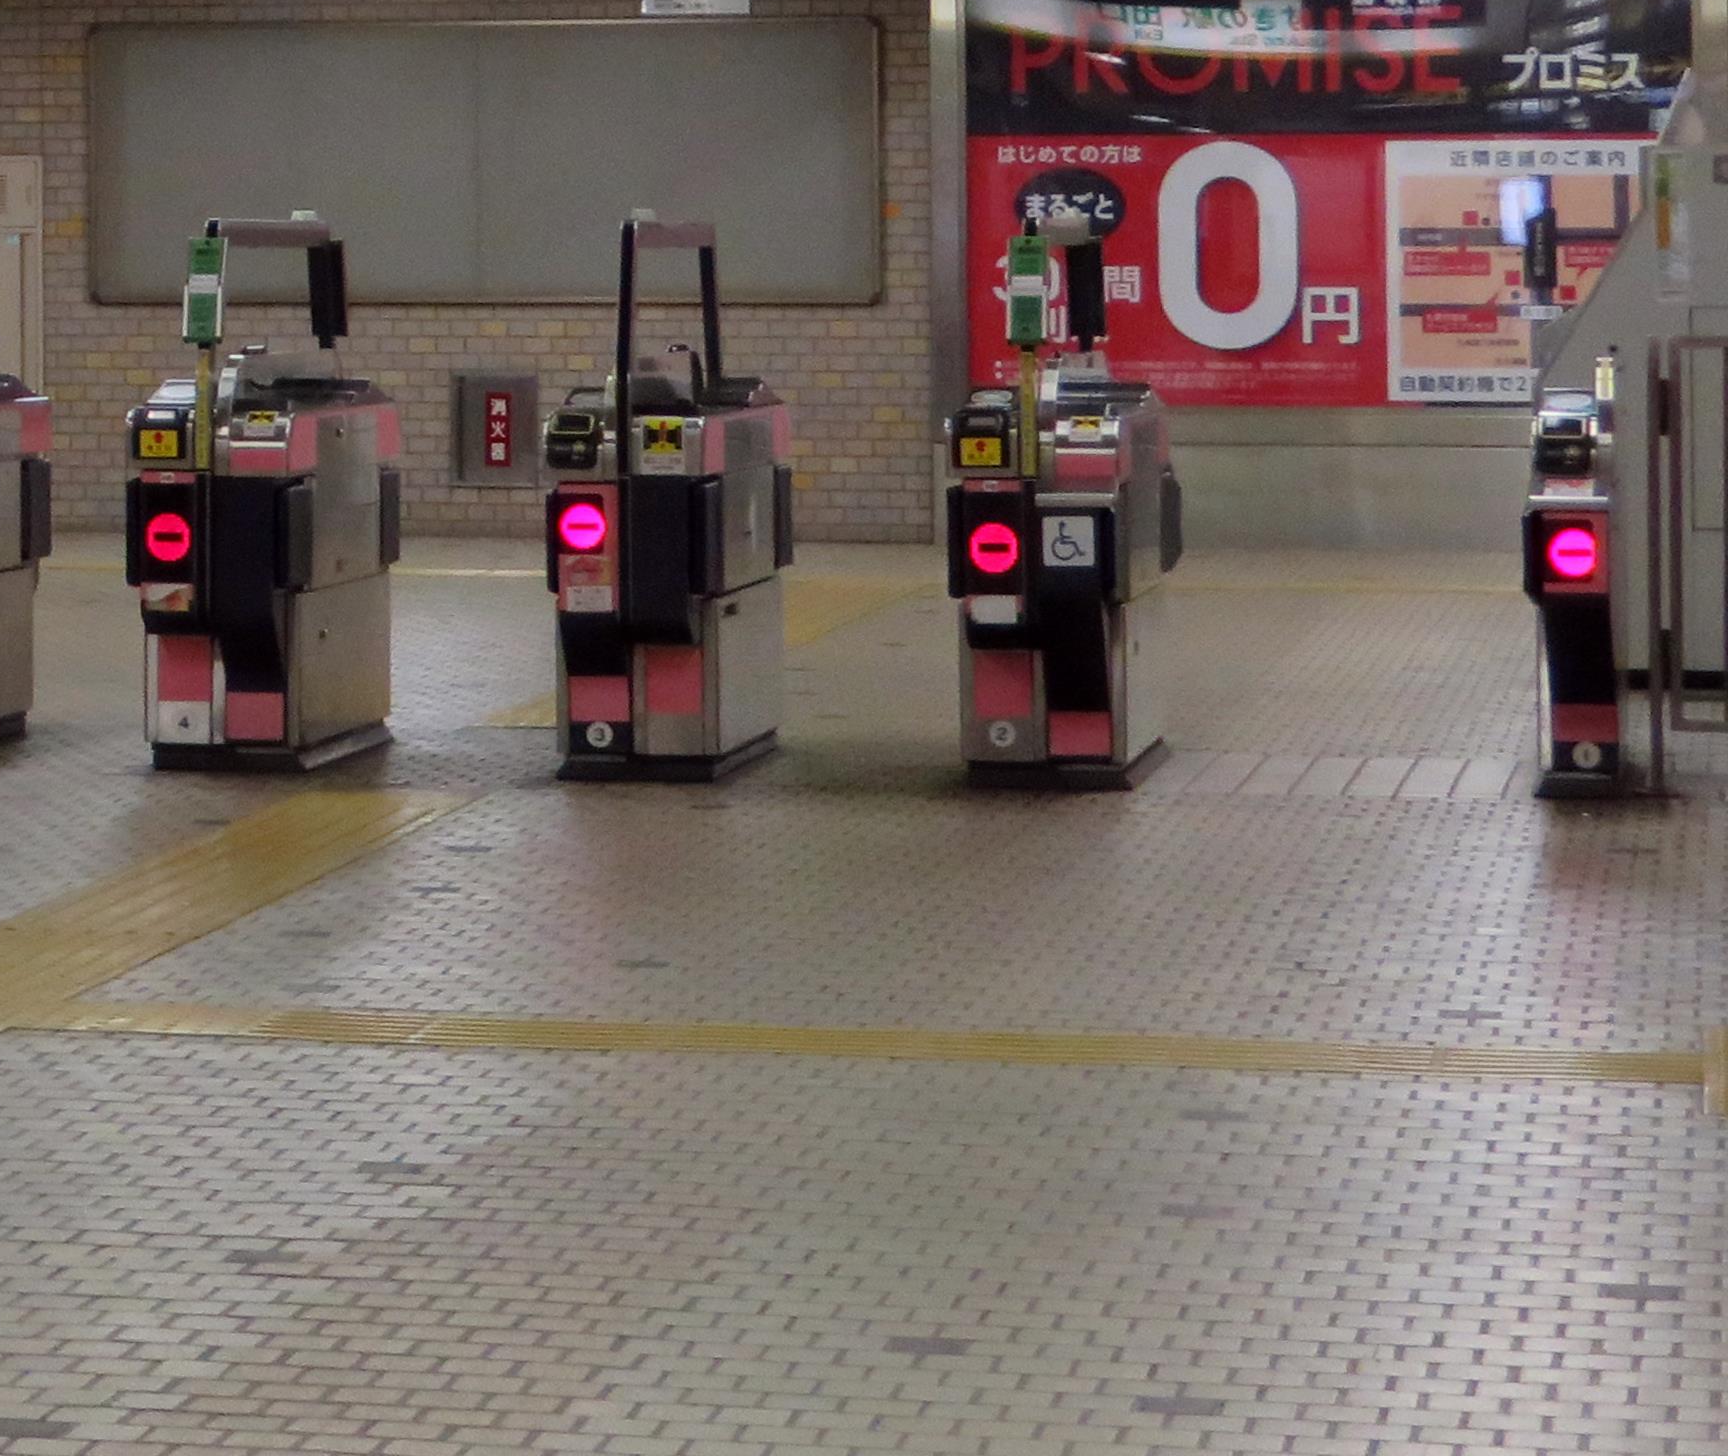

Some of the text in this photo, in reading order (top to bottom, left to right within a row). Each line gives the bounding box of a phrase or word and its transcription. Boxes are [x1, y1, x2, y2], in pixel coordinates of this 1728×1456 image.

[1008, 5, 1463, 95] PROMISE
[1501, 46, 1645, 91] プロミス
[997, 144, 1143, 164] はじめての方は
[1024, 192, 1115, 220] まるごと
